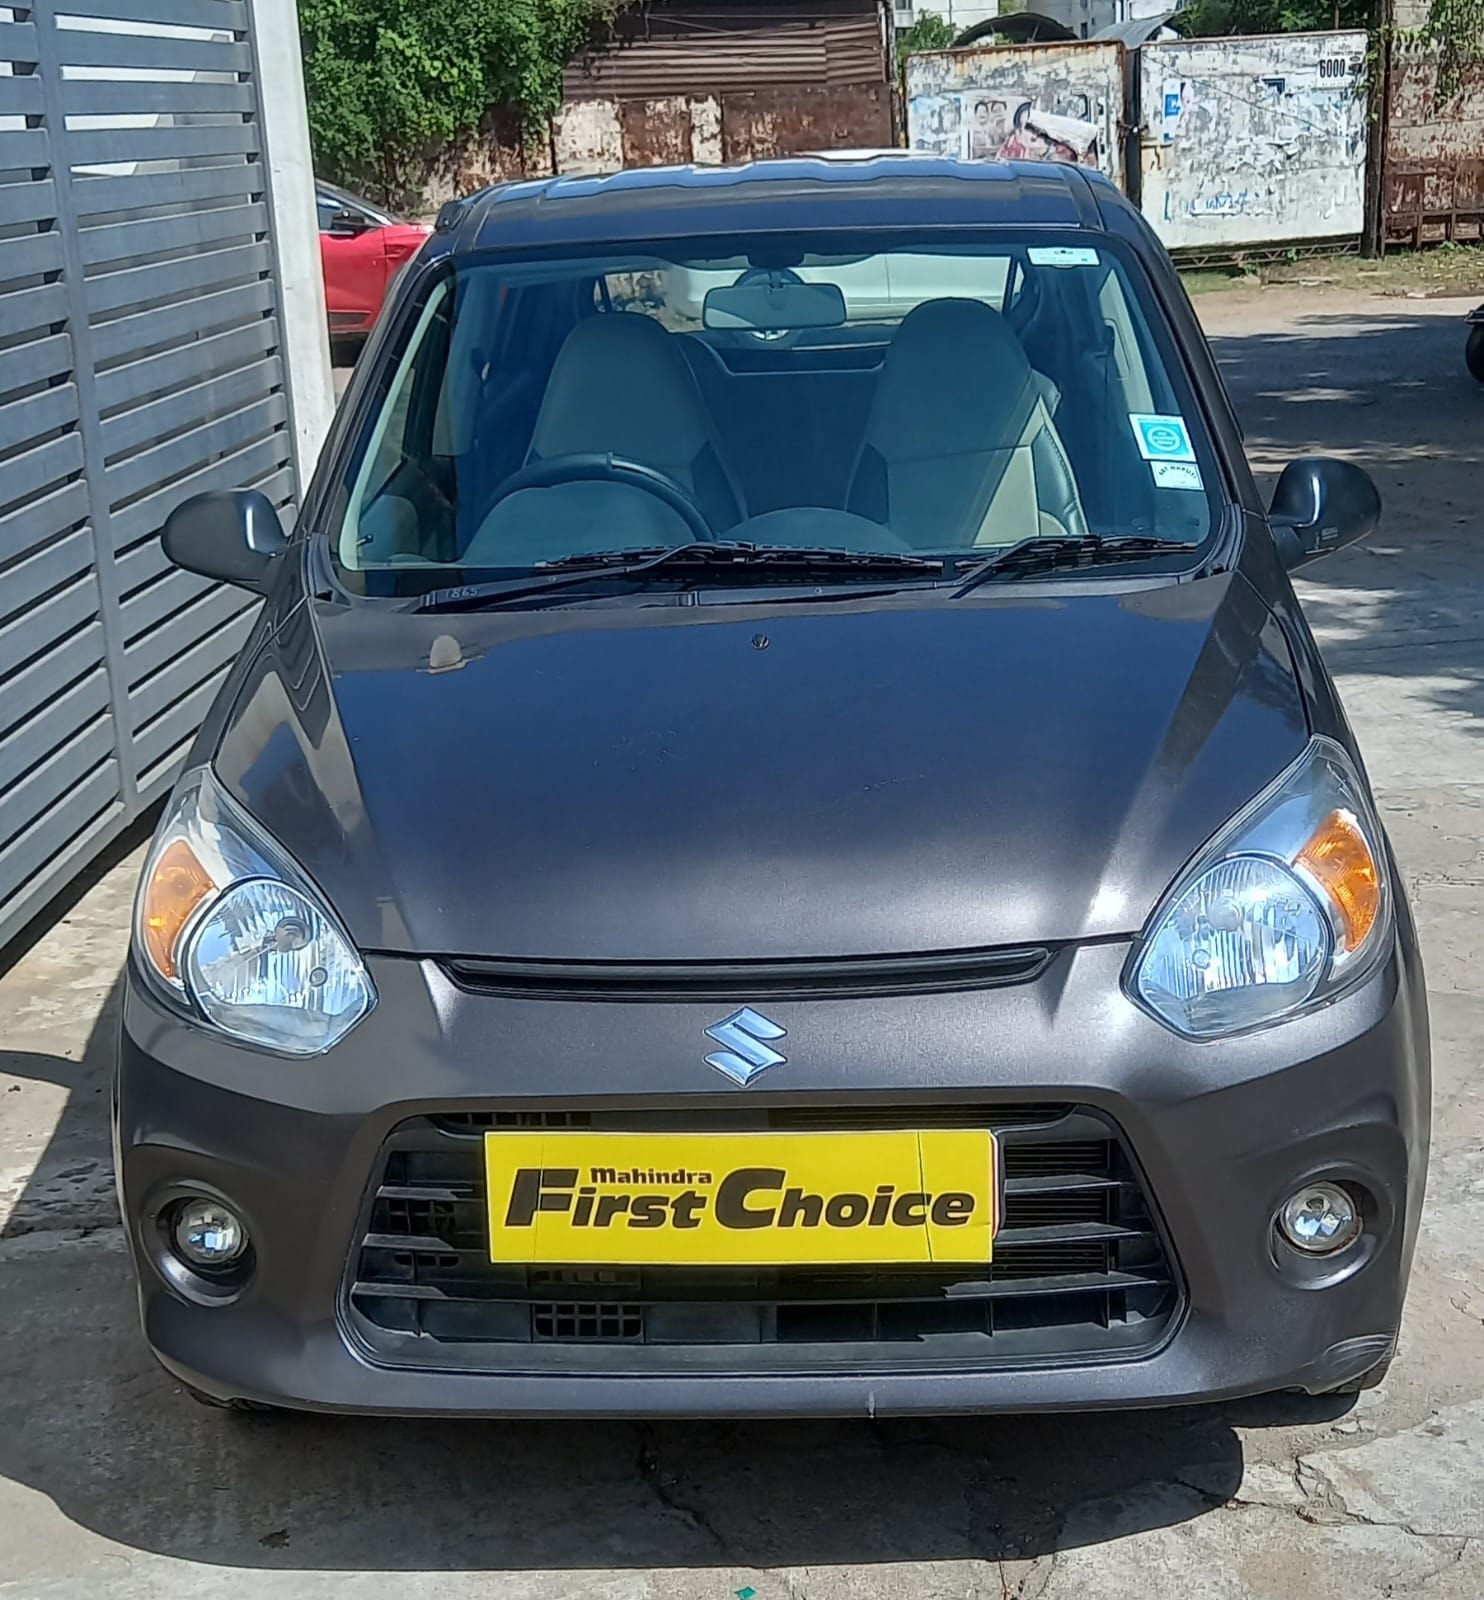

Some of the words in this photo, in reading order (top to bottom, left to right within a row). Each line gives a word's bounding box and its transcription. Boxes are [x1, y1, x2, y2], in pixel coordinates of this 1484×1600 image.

[1320, 58, 1346, 78] 6000
[590, 1167, 713, 1185] Mahindra
[503, 1168, 706, 1228] First
[714, 1168, 976, 1229] Choice
